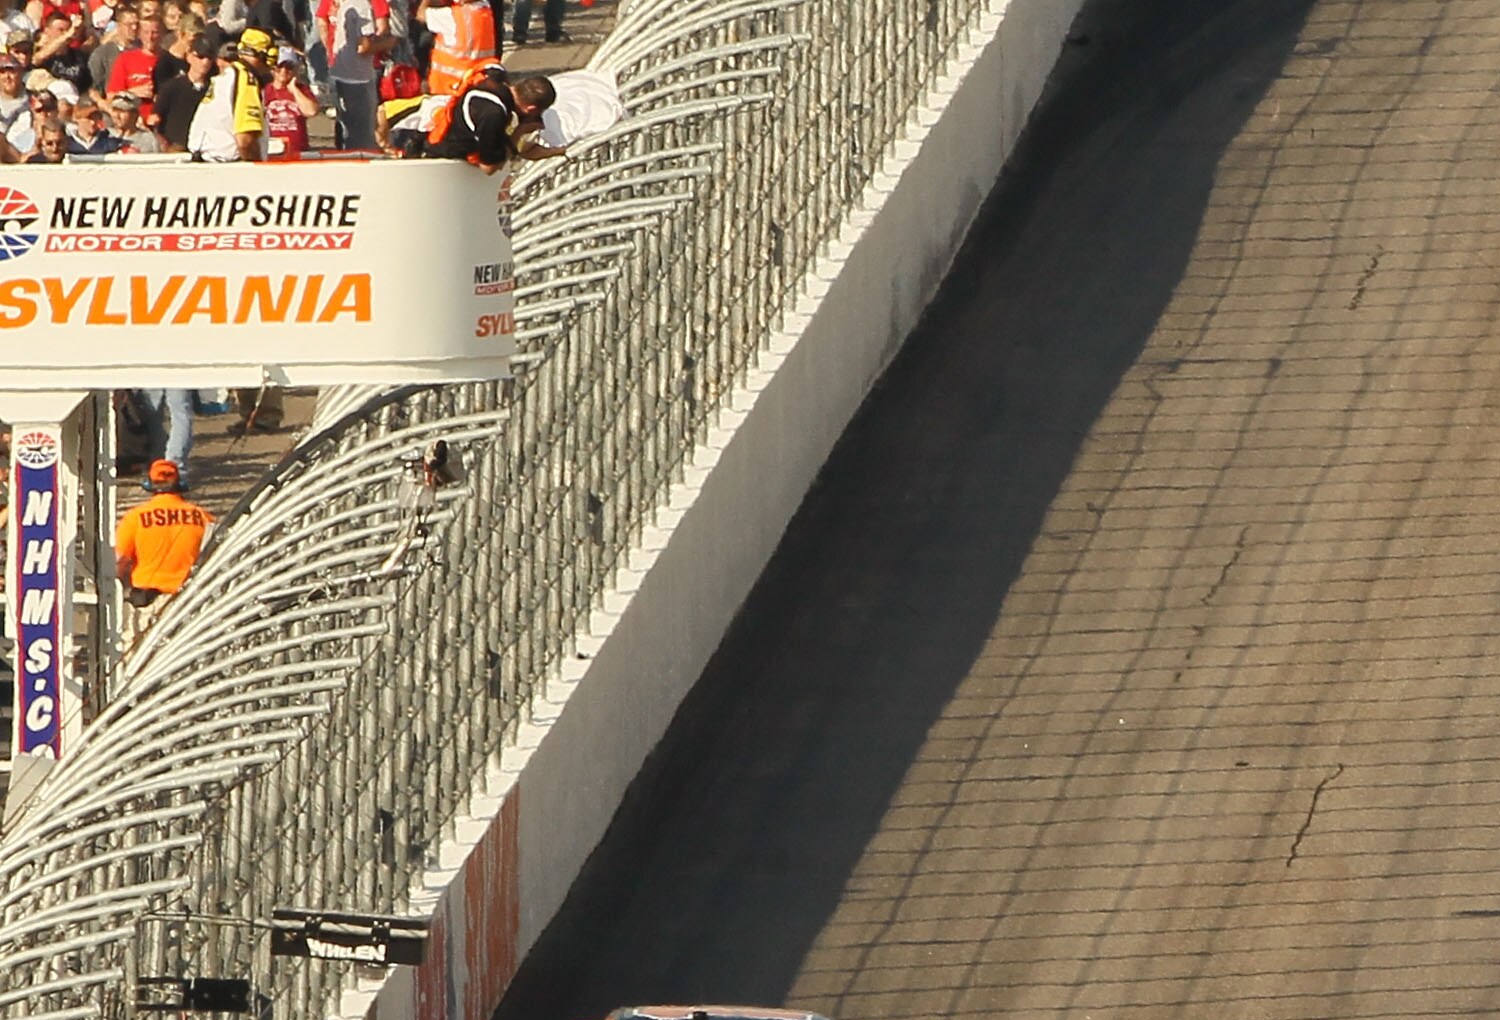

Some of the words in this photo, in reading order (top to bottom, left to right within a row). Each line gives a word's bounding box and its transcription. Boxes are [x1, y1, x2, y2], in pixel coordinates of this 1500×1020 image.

[50, 196, 136, 229] NEW
[142, 194, 361, 228] HAMPSHIRE
[51, 234, 162, 251] MOTOR
[177, 233, 350, 250] SPEEDWAY
[474, 264, 500, 284] NEW
[0, 273, 372, 328] SYLVANIA
[140, 508, 204, 528] USHER
[306, 938, 386, 961] WHELEN
